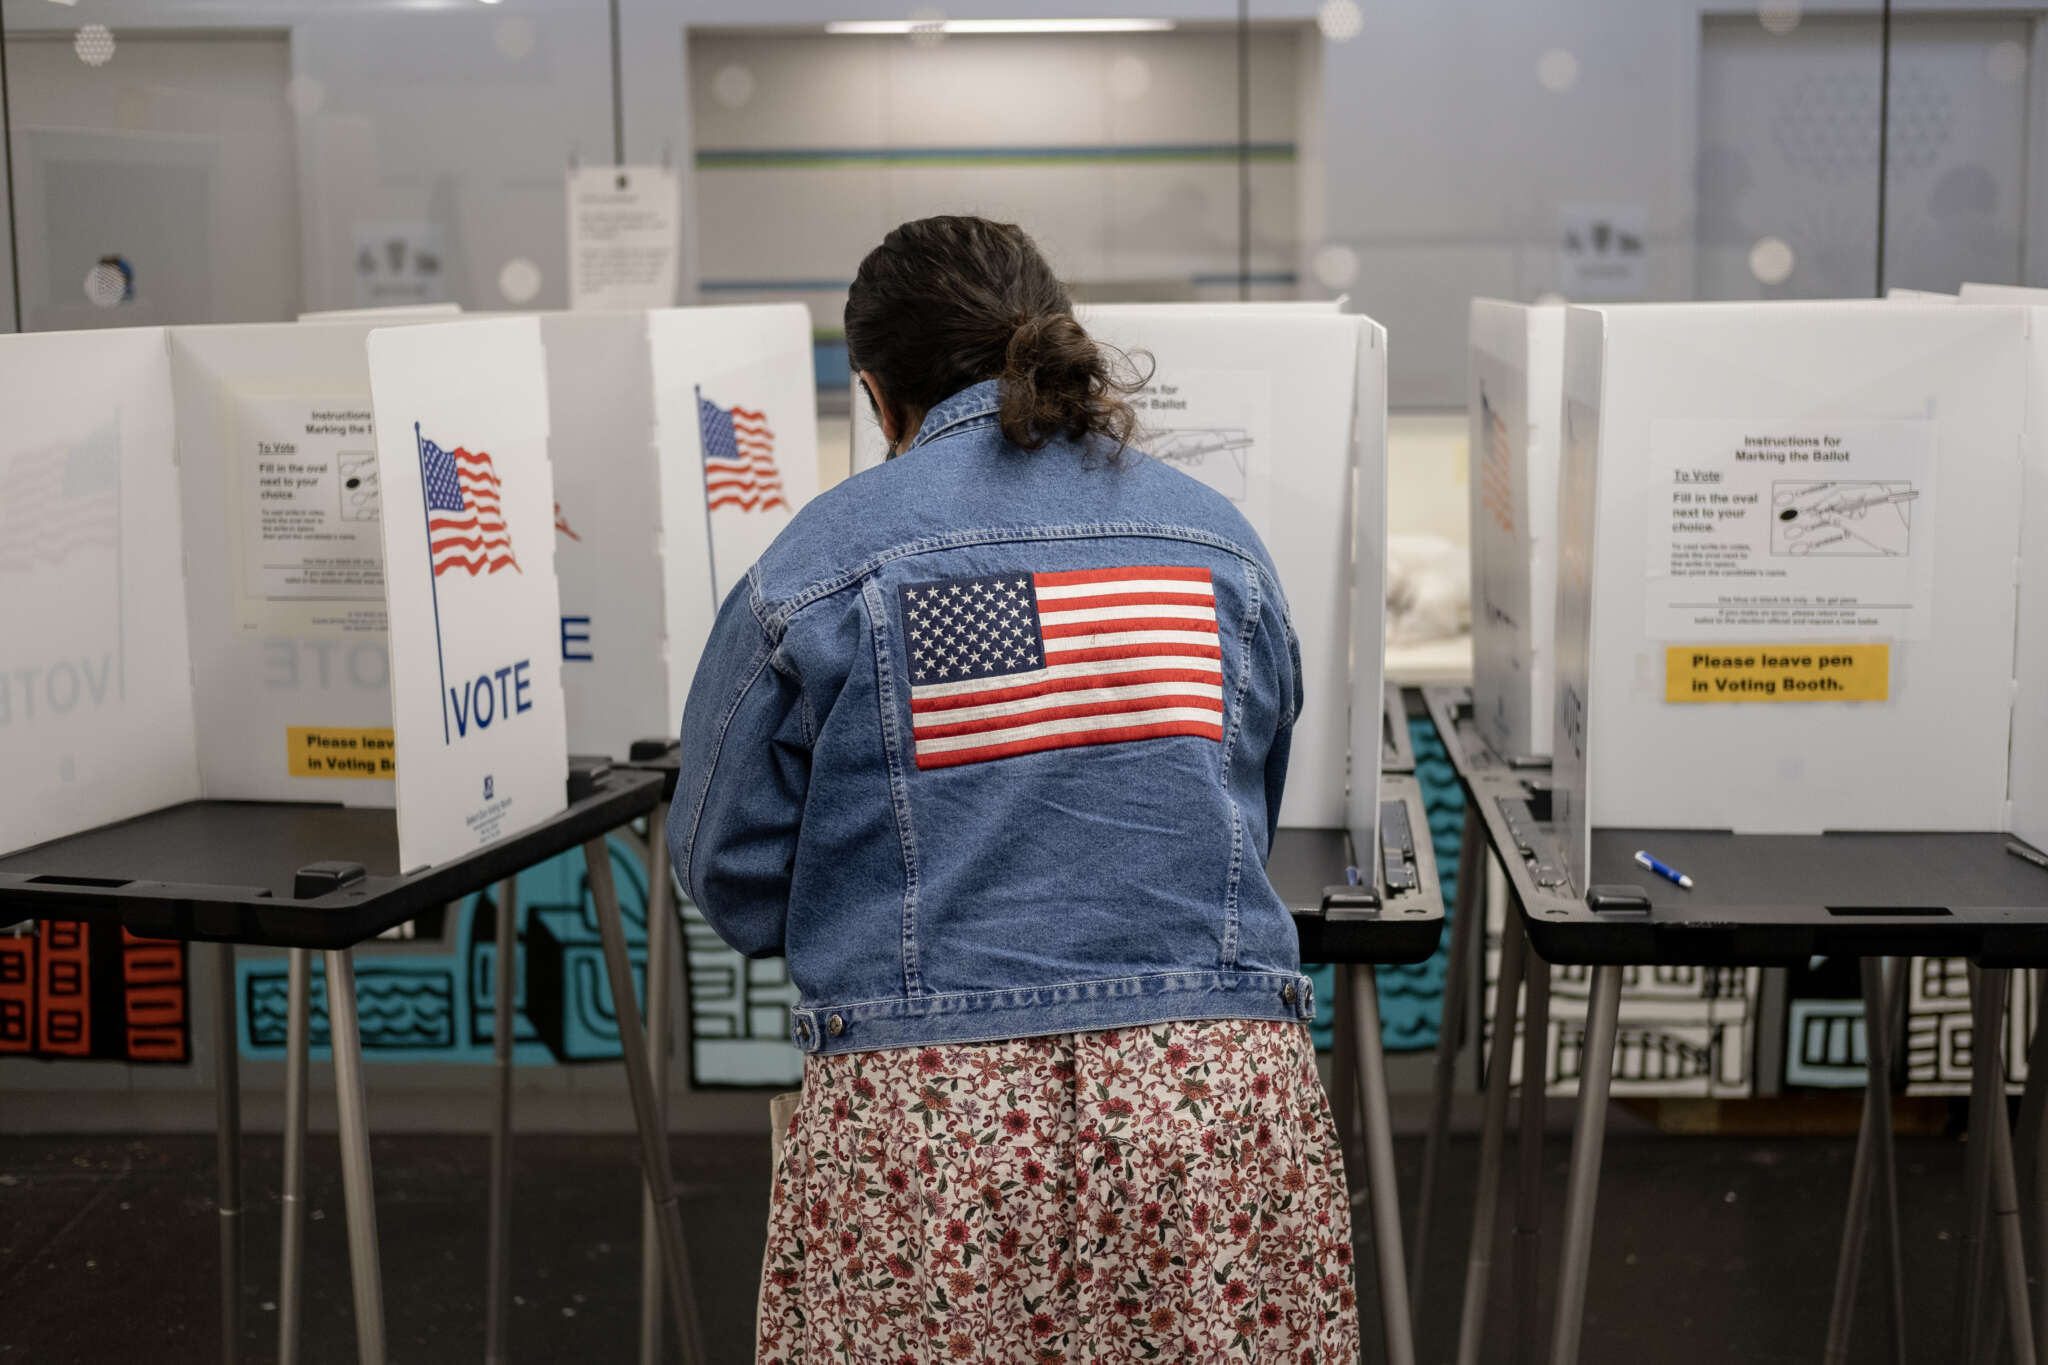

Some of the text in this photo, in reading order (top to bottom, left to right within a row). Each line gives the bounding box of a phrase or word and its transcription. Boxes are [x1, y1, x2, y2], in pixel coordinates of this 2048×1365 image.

[1151, 399, 1187, 410] Ballot
[305, 424, 347, 436] Marking
[348, 424, 365, 434] the
[1744, 435, 1842, 447] Instructions for
[1735, 450, 1850, 464] Marking the Ballot
[1674, 470, 1689, 483] To
[1673, 492, 1758, 503] Fill in the oval
[1672, 507, 1745, 521] next to your
[1692, 653, 1854, 670] Please leave pen
[1692, 676, 1844, 695] in Voting Booth.
[450, 659, 532, 738] VOTE
[306, 733, 395, 750] Please leav
[307, 756, 322, 770] in
[326, 756, 376, 775] Voting
